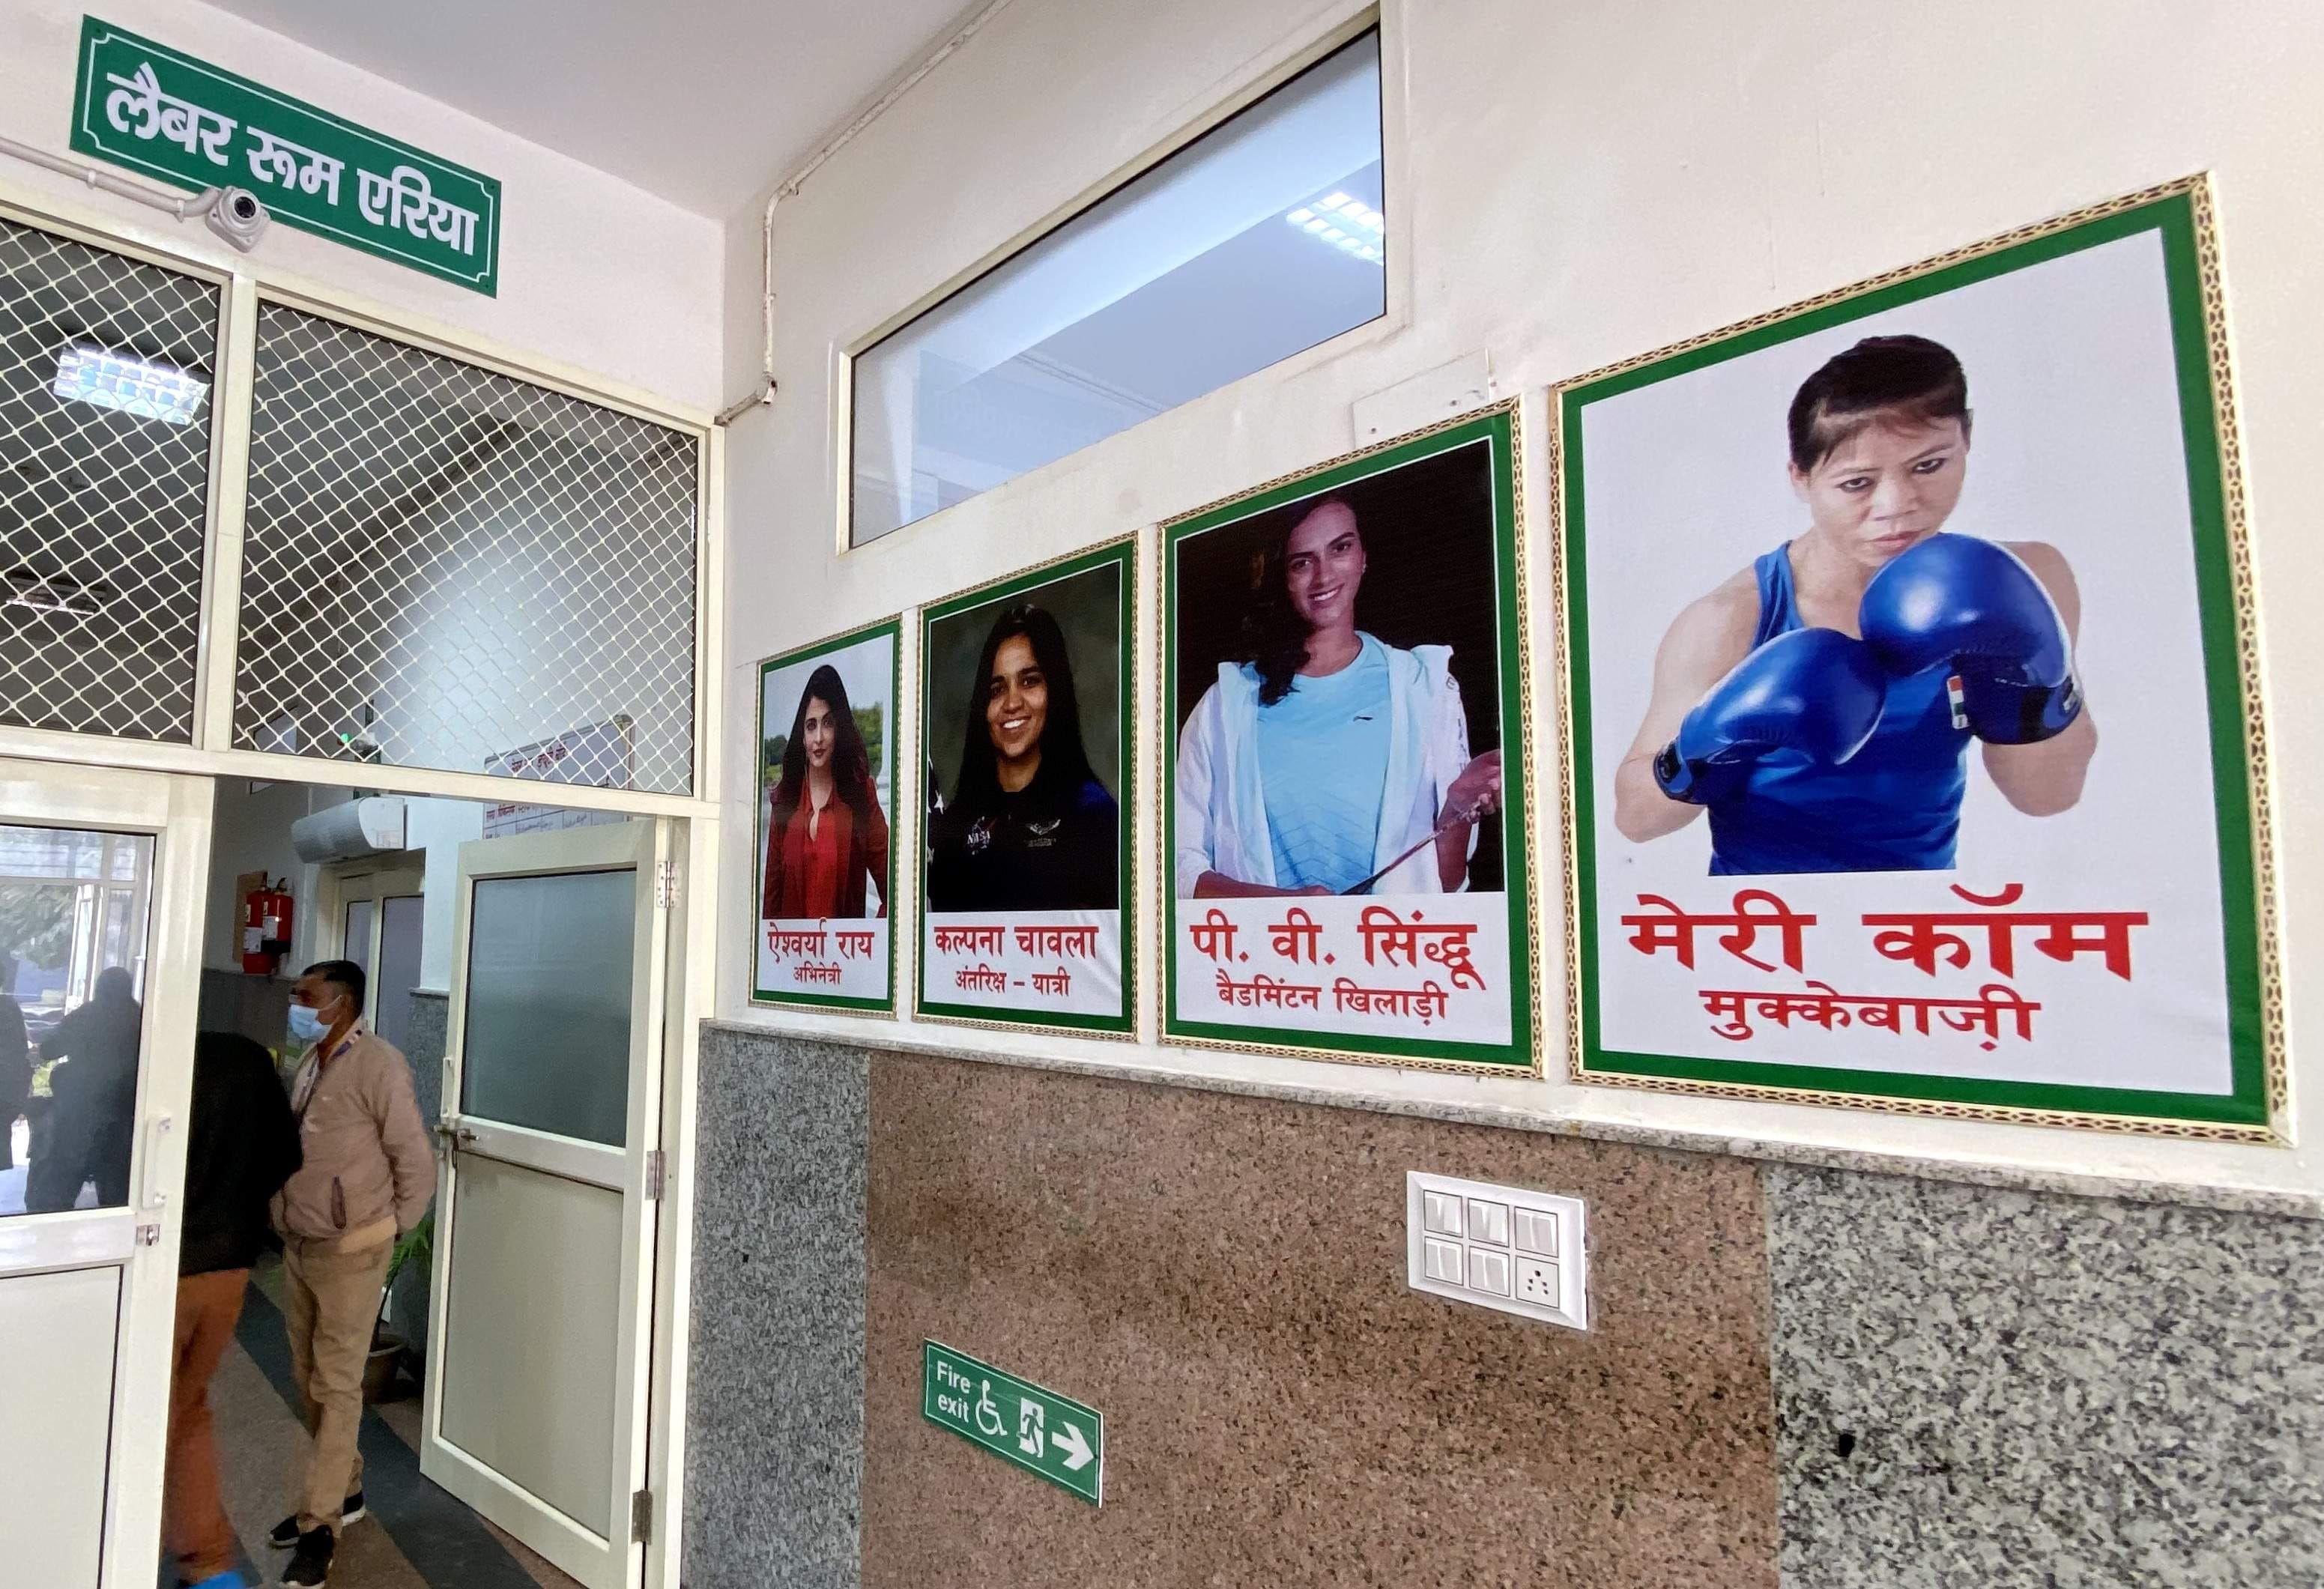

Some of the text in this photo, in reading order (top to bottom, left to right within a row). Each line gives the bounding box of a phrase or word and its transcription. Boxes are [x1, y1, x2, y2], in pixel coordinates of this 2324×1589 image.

[106, 61, 479, 255] लैबर रूम एरिया
[767, 918, 875, 964] ऐश्वर्या राय
[933, 925, 1099, 960] कल्पना चावला
[1189, 907, 1250, 963] पी.
[1267, 907, 1336, 966] वी.
[1621, 882, 2149, 981] मेरी कॉम
[793, 960, 843, 985] अभिनेत्री
[954, 963, 1007, 994] अंतरिक्ष
[1032, 966, 1071, 997] यात्री
[1215, 968, 1449, 1026] बैडमिंटन खिलाड़ी
[1698, 979, 2042, 1052] मुक्केबाज़ी
[936, 1360, 971, 1393] Fire
[936, 1393, 969, 1423] exit
